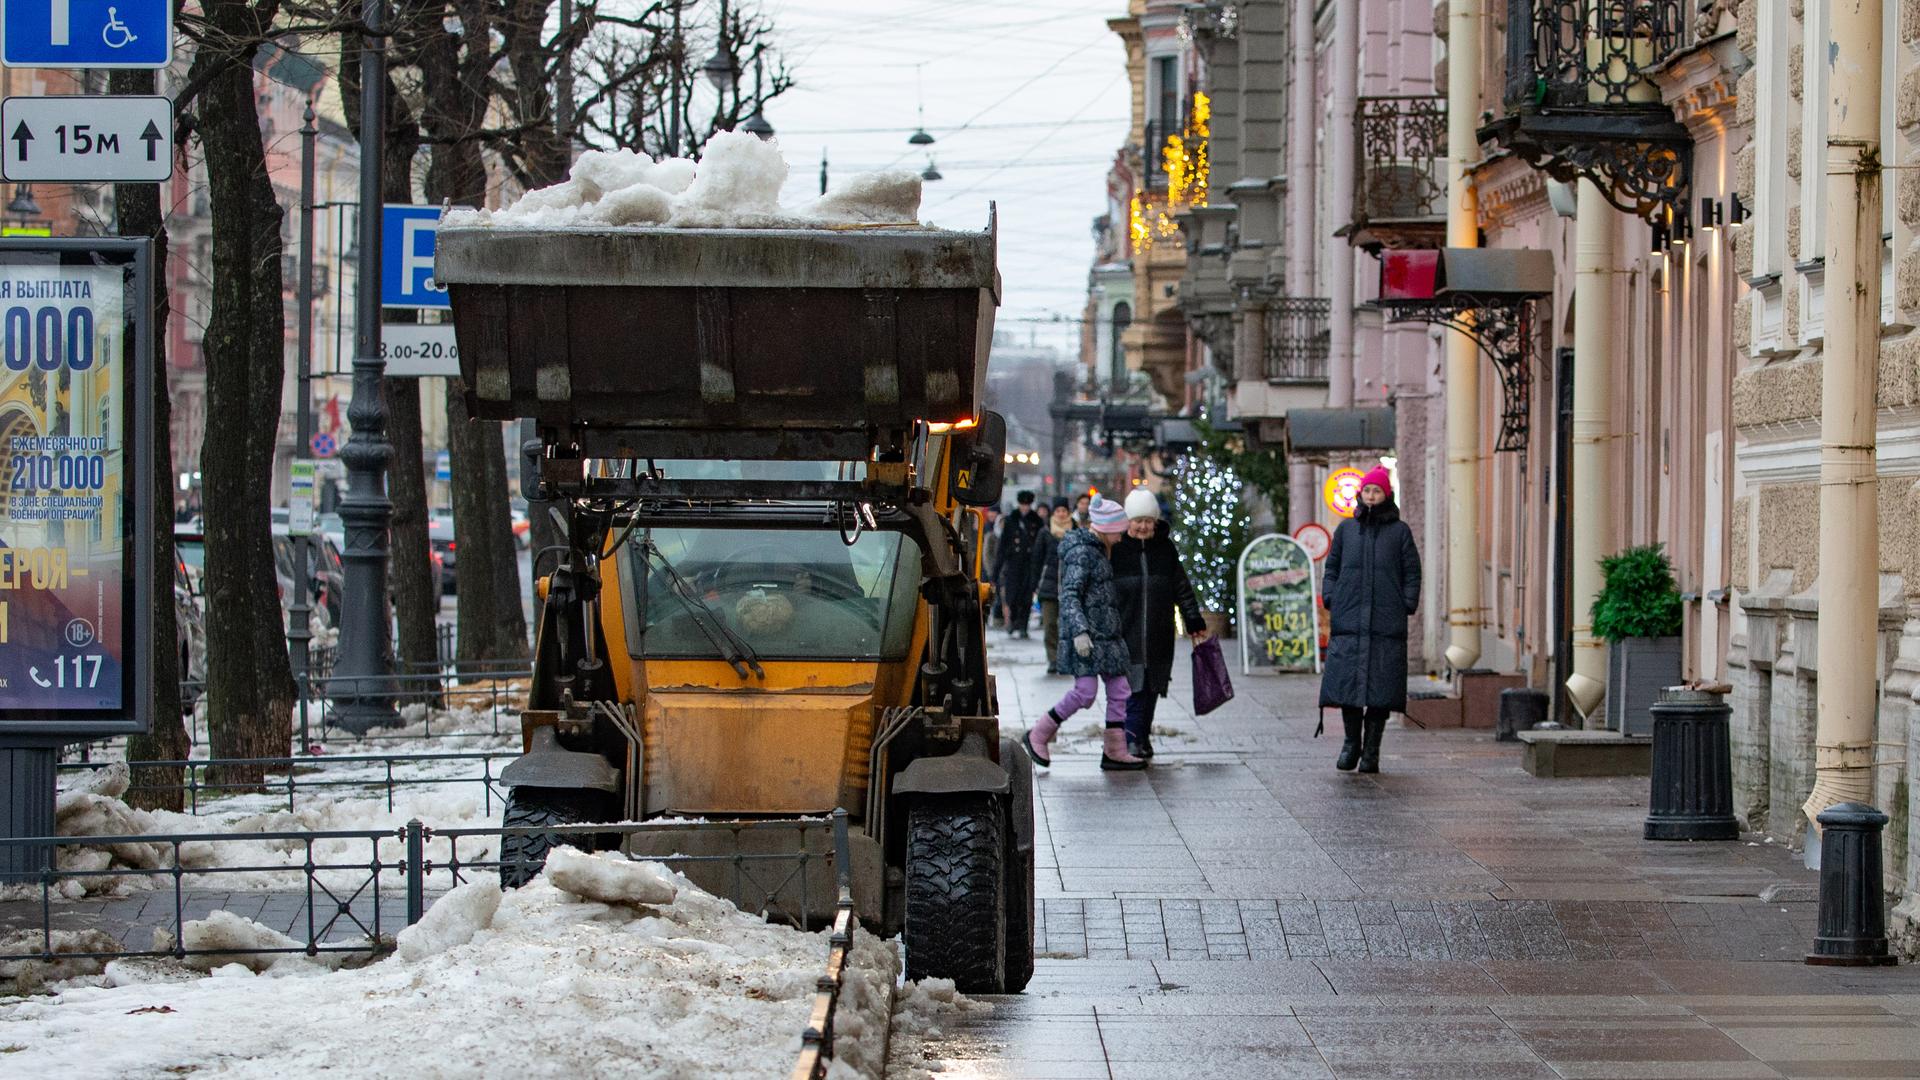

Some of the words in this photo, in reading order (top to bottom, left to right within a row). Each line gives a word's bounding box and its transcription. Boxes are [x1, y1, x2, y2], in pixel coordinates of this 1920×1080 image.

[54, 124, 120, 155] 15м
[0, 280, 11, 299] Я
[16, 280, 92, 299] ВЫПЛАТА
[11, 436, 87, 451] ЕЖЕМЕСЯЧНО
[90, 436, 104, 451] ОТ
[11, 455, 53, 490] 210
[59, 455, 104, 490] 000
[11, 497, 17, 507] В
[18, 497, 40, 507] ЗОНЕ
[41, 496, 104, 508] СПЕЦИАЛЬНОЙ
[11, 508, 49, 519] ВОЕННОЙ
[51, 509, 95, 520] ОПЕРАЦИИ
[71, 623, 91, 642] 18+
[54, 655, 103, 688] 117
